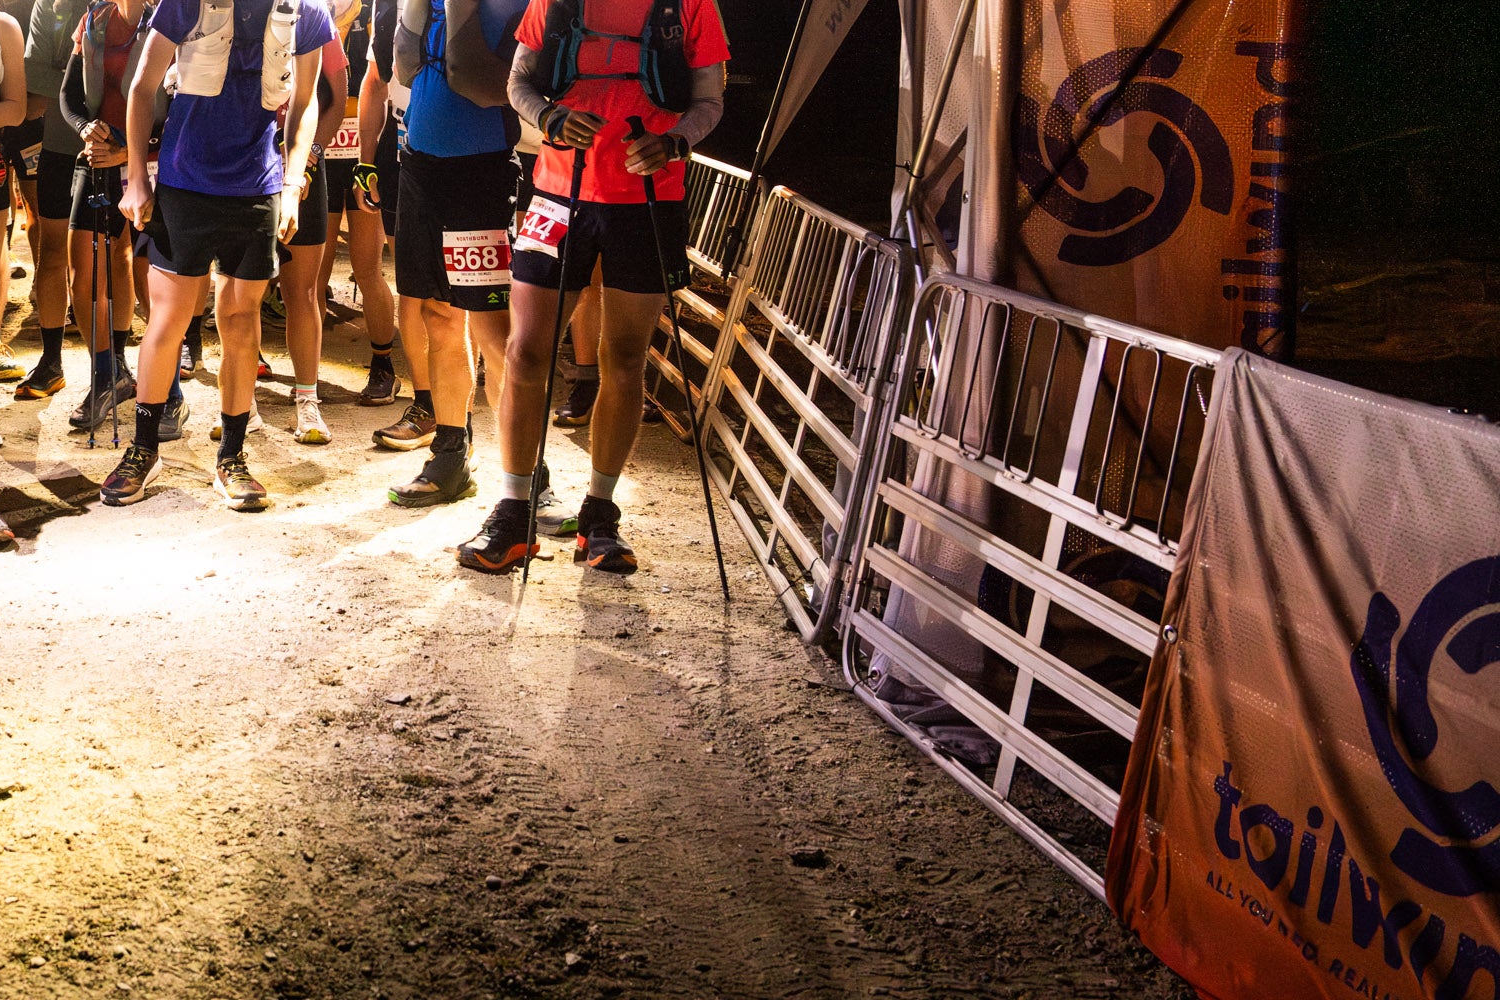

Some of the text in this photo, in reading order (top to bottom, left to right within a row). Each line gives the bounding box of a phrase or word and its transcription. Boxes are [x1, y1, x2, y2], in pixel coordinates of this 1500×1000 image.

[453, 246, 499, 270] 568
[1206, 869, 1235, 900] ALL
[1239, 889, 1274, 926] YOU
